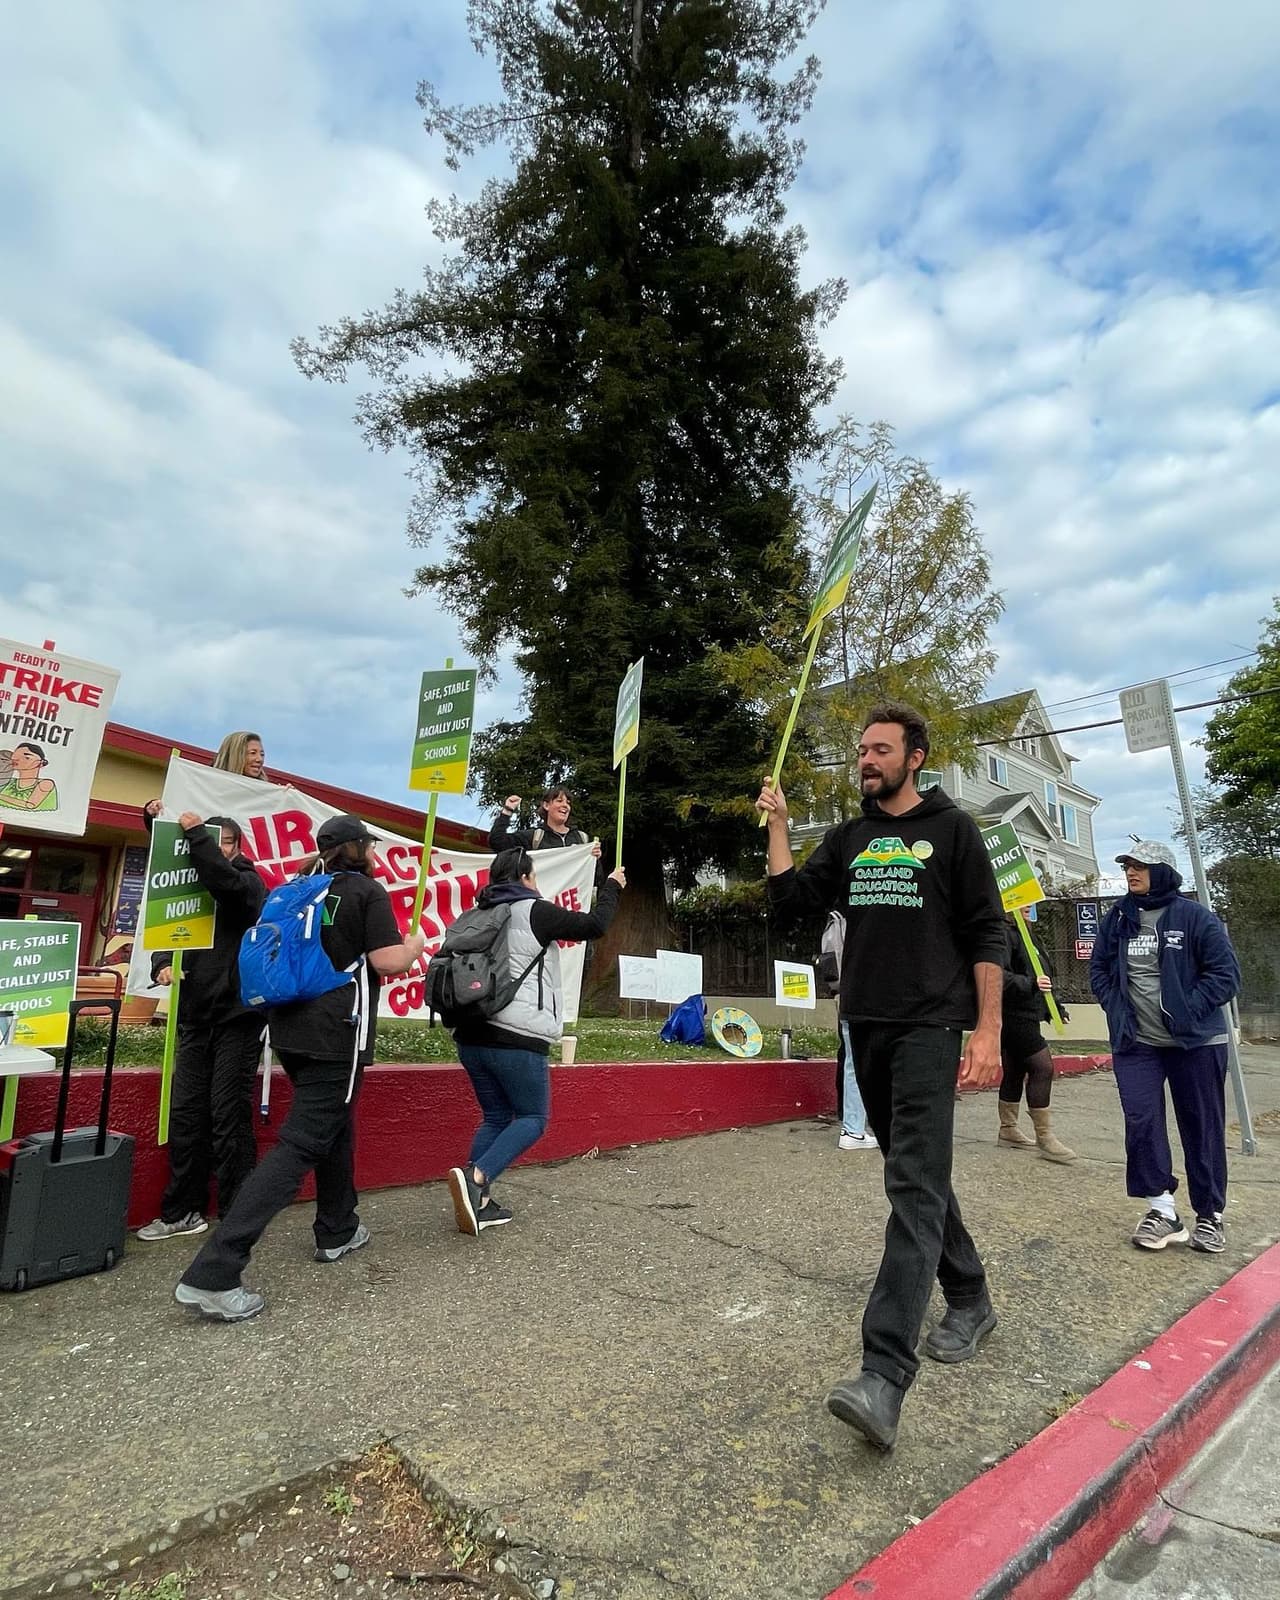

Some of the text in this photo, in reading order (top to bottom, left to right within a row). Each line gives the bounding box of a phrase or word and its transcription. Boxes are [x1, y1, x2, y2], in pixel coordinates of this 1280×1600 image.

[13, 652, 60, 672] READY TO
[0, 663, 104, 709] TRIKE
[423, 680, 471, 702] SAFE, STABLE
[13, 693, 59, 722] FAIR
[1124, 691, 1143, 708] NO
[437, 702, 454, 716] AND
[0, 713, 74, 747] NTRACT
[419, 717, 471, 739] RACIALLY JUST
[424, 744, 457, 761] SCHOOLS
[868, 837, 906, 853] OEA
[991, 845, 1022, 870] TRACT
[855, 867, 914, 879] OAKLAND
[850, 880, 918, 894] EDUCATION
[166, 897, 202, 919] NOW!
[23, 934, 69, 949] STABLE
[13, 954, 42, 968] AND
[41, 969, 72, 984] JUST
